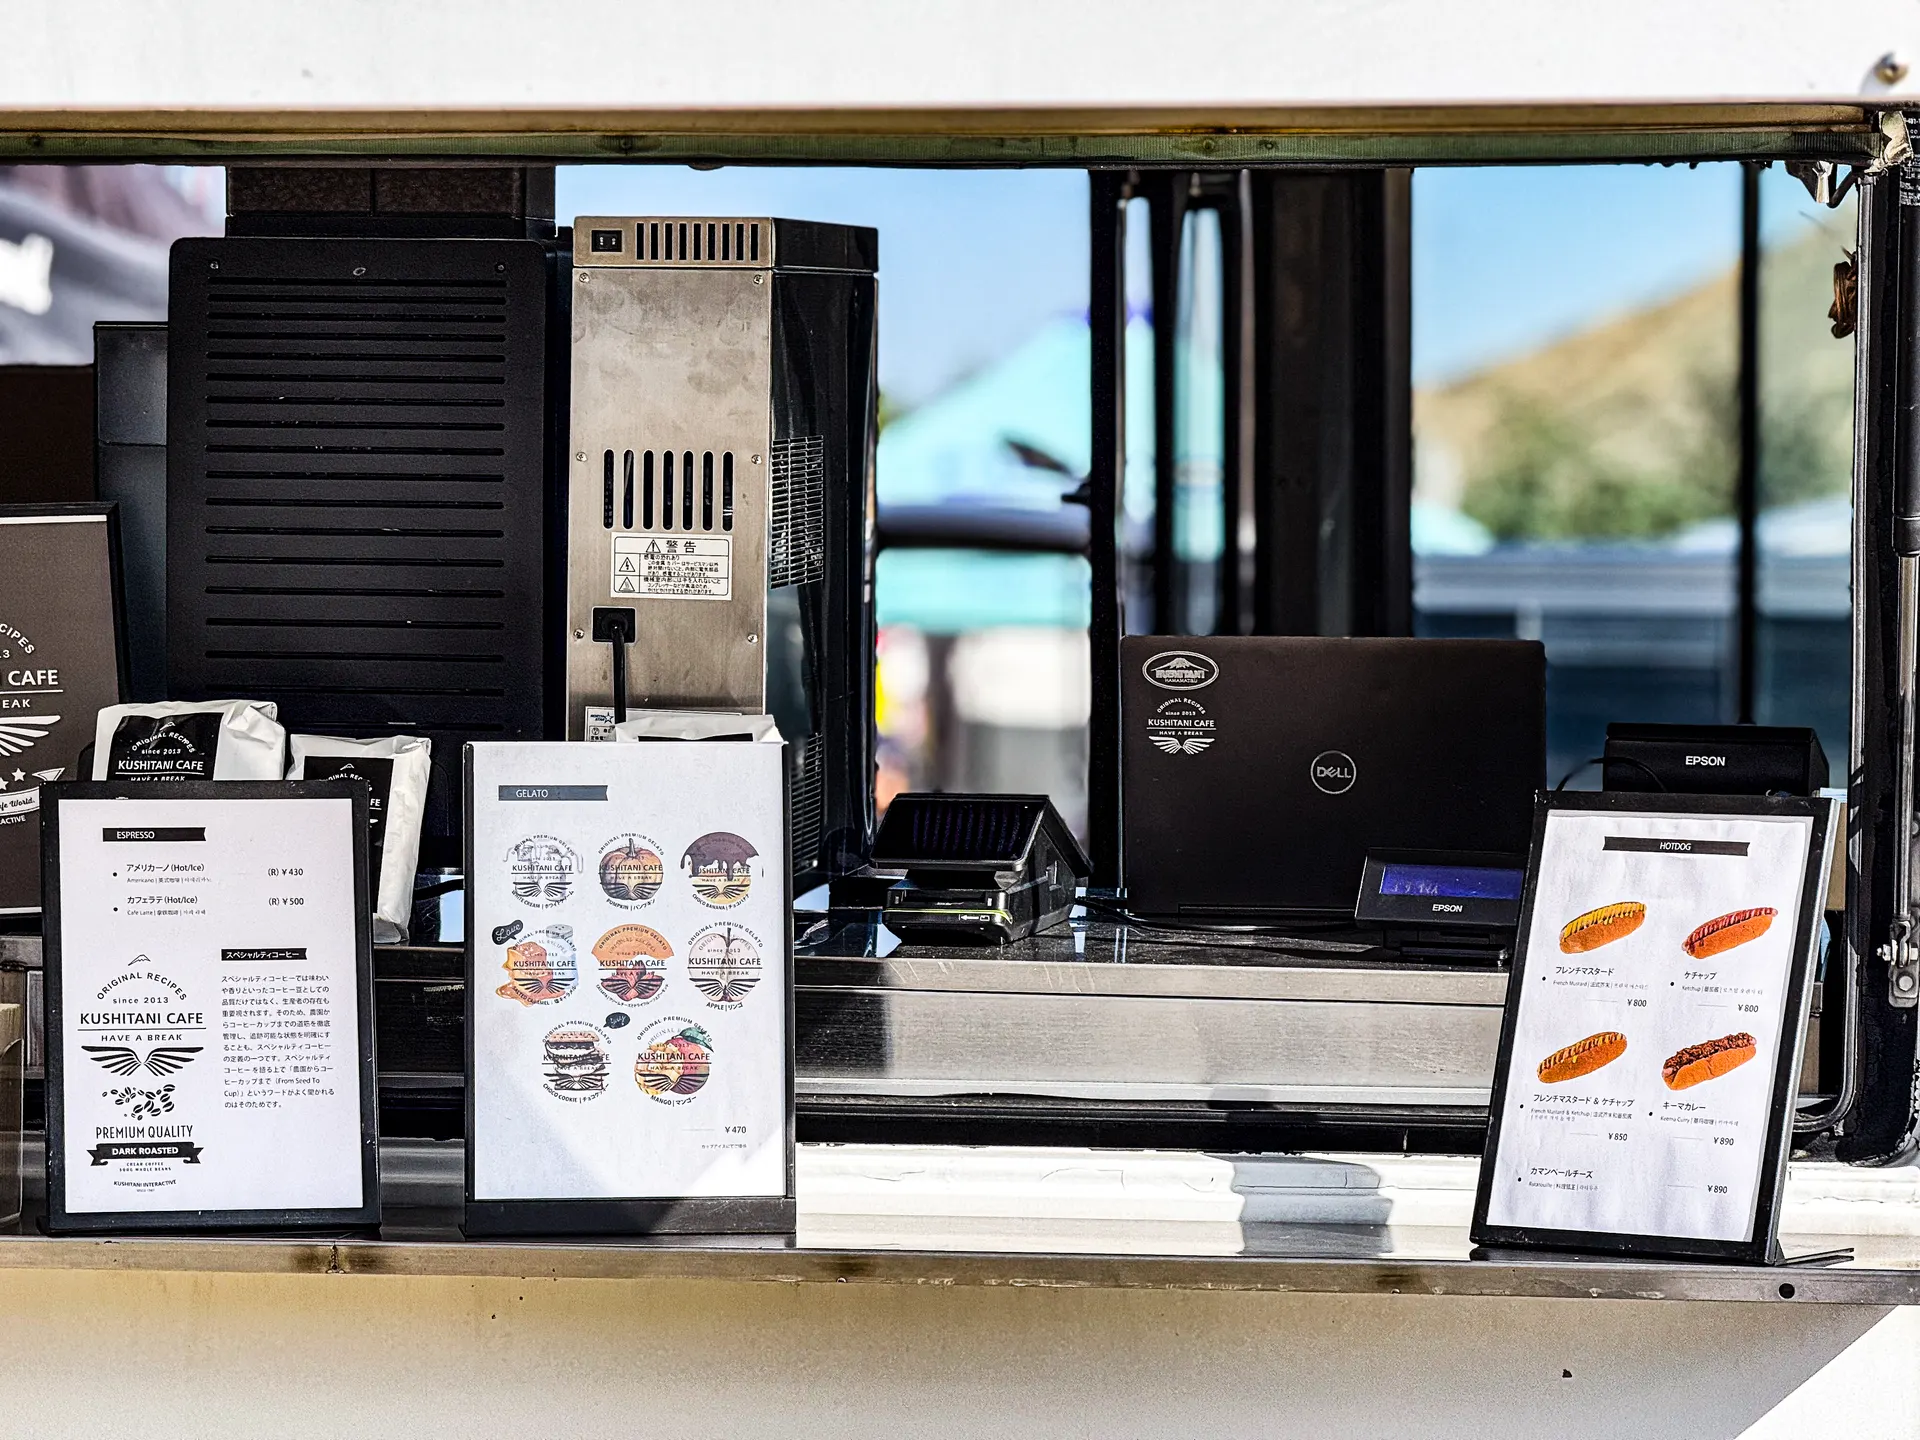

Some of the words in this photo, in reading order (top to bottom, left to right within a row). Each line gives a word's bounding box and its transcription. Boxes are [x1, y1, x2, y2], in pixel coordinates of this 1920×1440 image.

[666, 540, 697, 553] 警告
[8, 670, 59, 686] CAFE
[1157, 697, 1182, 713] ORIGINAL
[1183, 697, 1206, 715] RECIPES
[1148, 719, 1192, 727] KUSHITANI
[1194, 719, 1215, 728] CAFE
[131, 732, 167, 752] ORIGINAL
[118, 760, 174, 770] KUSHITANI
[176, 760, 204, 771] CAFE
[1685, 756, 1726, 766] EPSON
[1317, 766, 1351, 778] DELL
[516, 789, 549, 798] GELATO
[116, 831, 155, 839] ESPRESSO
[598, 836, 620, 854] ORIGINAL
[648, 838, 664, 856] GELATO
[1659, 841, 1692, 850] HOTDOG
[268, 868, 279, 876] (R)
[268, 897, 280, 906] (R)
[692, 894, 706, 906] CHOCO
[706, 901, 726, 910] BANANA
[1432, 904, 1463, 912] EPSON
[688, 924, 713, 946] ORIGINAL
[714, 921, 743, 929] PREMIUM
[744, 927, 763, 948] GELATO
[599, 930, 621, 949] ORIGINAL
[650, 932, 667, 951] GELATO
[226, 951, 300, 959] スペシャルティコーヒー
[1555, 966, 1615, 976] フレンチマスタード
[1684, 971, 1717, 980] ケチャップ
[97, 972, 143, 1000] ORIGINAL
[146, 972, 187, 1001] RECIPES
[706, 1002, 724, 1010] APPLE
[728, 1002, 743, 1010] リンゴ
[1627, 999, 1648, 1007] ¥800
[1738, 1004, 1759, 1013] ¥800
[80, 1013, 161, 1025] KUSHITANI
[166, 1013, 203, 1024] CAFE
[637, 1019, 662, 1041] ORIGINAL
[663, 1016, 693, 1024] PREMIUM
[542, 1023, 565, 1043] ORIGINAL
[594, 1026, 612, 1045] GELATO
[543, 1083, 559, 1098] CHOCO
[558, 1093, 578, 1102] COOKIE
[650, 1095, 672, 1106] MANGO
[675, 1096, 697, 1105] マンゴー
[1533, 1094, 1593, 1105] フレンチマスタード
[1593, 1097, 1600, 1105] &
[1601, 1098, 1635, 1107] ケチャップ
[1662, 1101, 1706, 1111] キーマカレー
[96, 1126, 145, 1139] PREMIUM
[148, 1125, 193, 1138] QUALITY
[725, 1126, 747, 1134] ¥470
[1608, 1132, 1628, 1141] ¥850
[1713, 1137, 1734, 1146] ¥890
[112, 1147, 137, 1156] DARK
[138, 1147, 179, 1155] ROASTED
[1530, 1167, 1593, 1178] カマンベールチーズ
[143, 1179, 176, 1187] INTERACTIVE
[1707, 1185, 1728, 1194] ¥890
